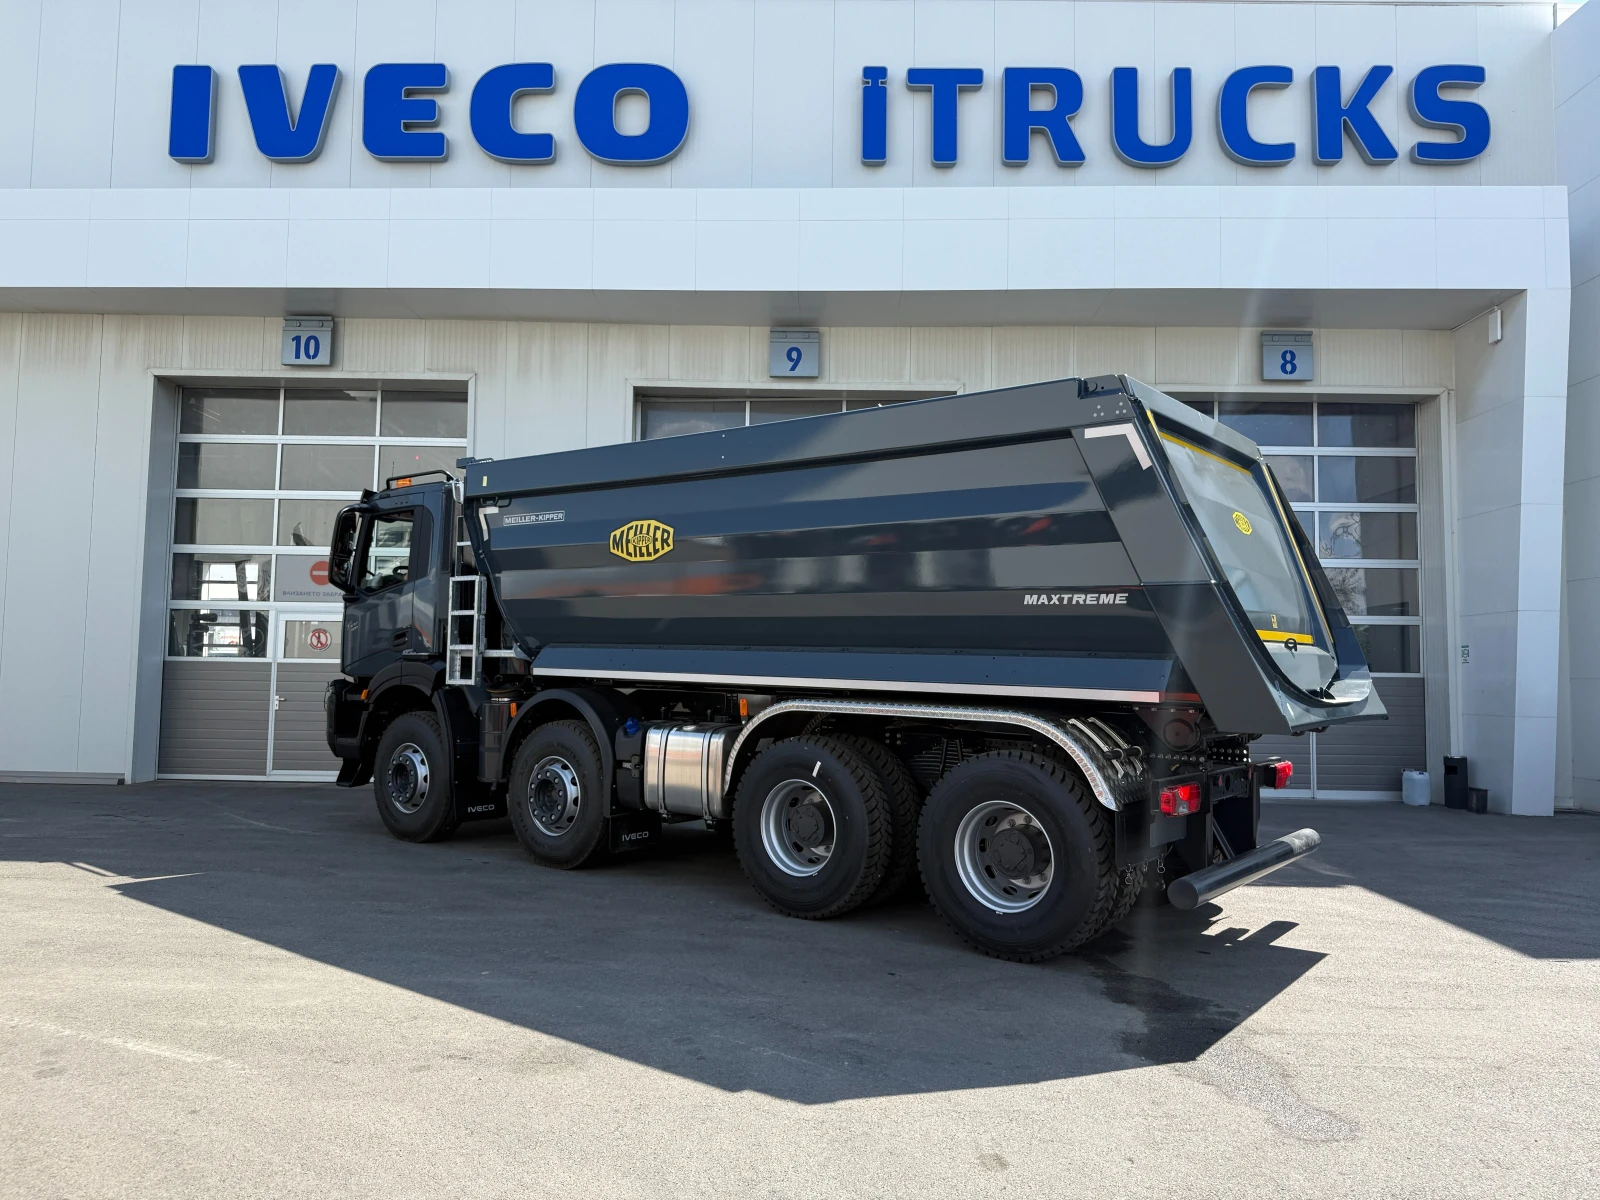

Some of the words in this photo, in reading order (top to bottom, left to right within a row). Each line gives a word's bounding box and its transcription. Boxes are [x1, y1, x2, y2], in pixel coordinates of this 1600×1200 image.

[168, 62, 690, 166] IVECO
[291, 334, 320, 360] 10
[786, 346, 803, 371] 9
[1280, 349, 1297, 375] 8
[504, 512, 563, 525] MEILLER-KIPPER
[611, 523, 672, 558] MEILLER
[632, 535, 652, 546] KIPPER
[282, 590, 321, 598] ВЛИЗАНЕТО
[1023, 593, 1129, 605] MAXTREME
[467, 804, 495, 813] IVECO
[622, 831, 649, 842] IVECO
